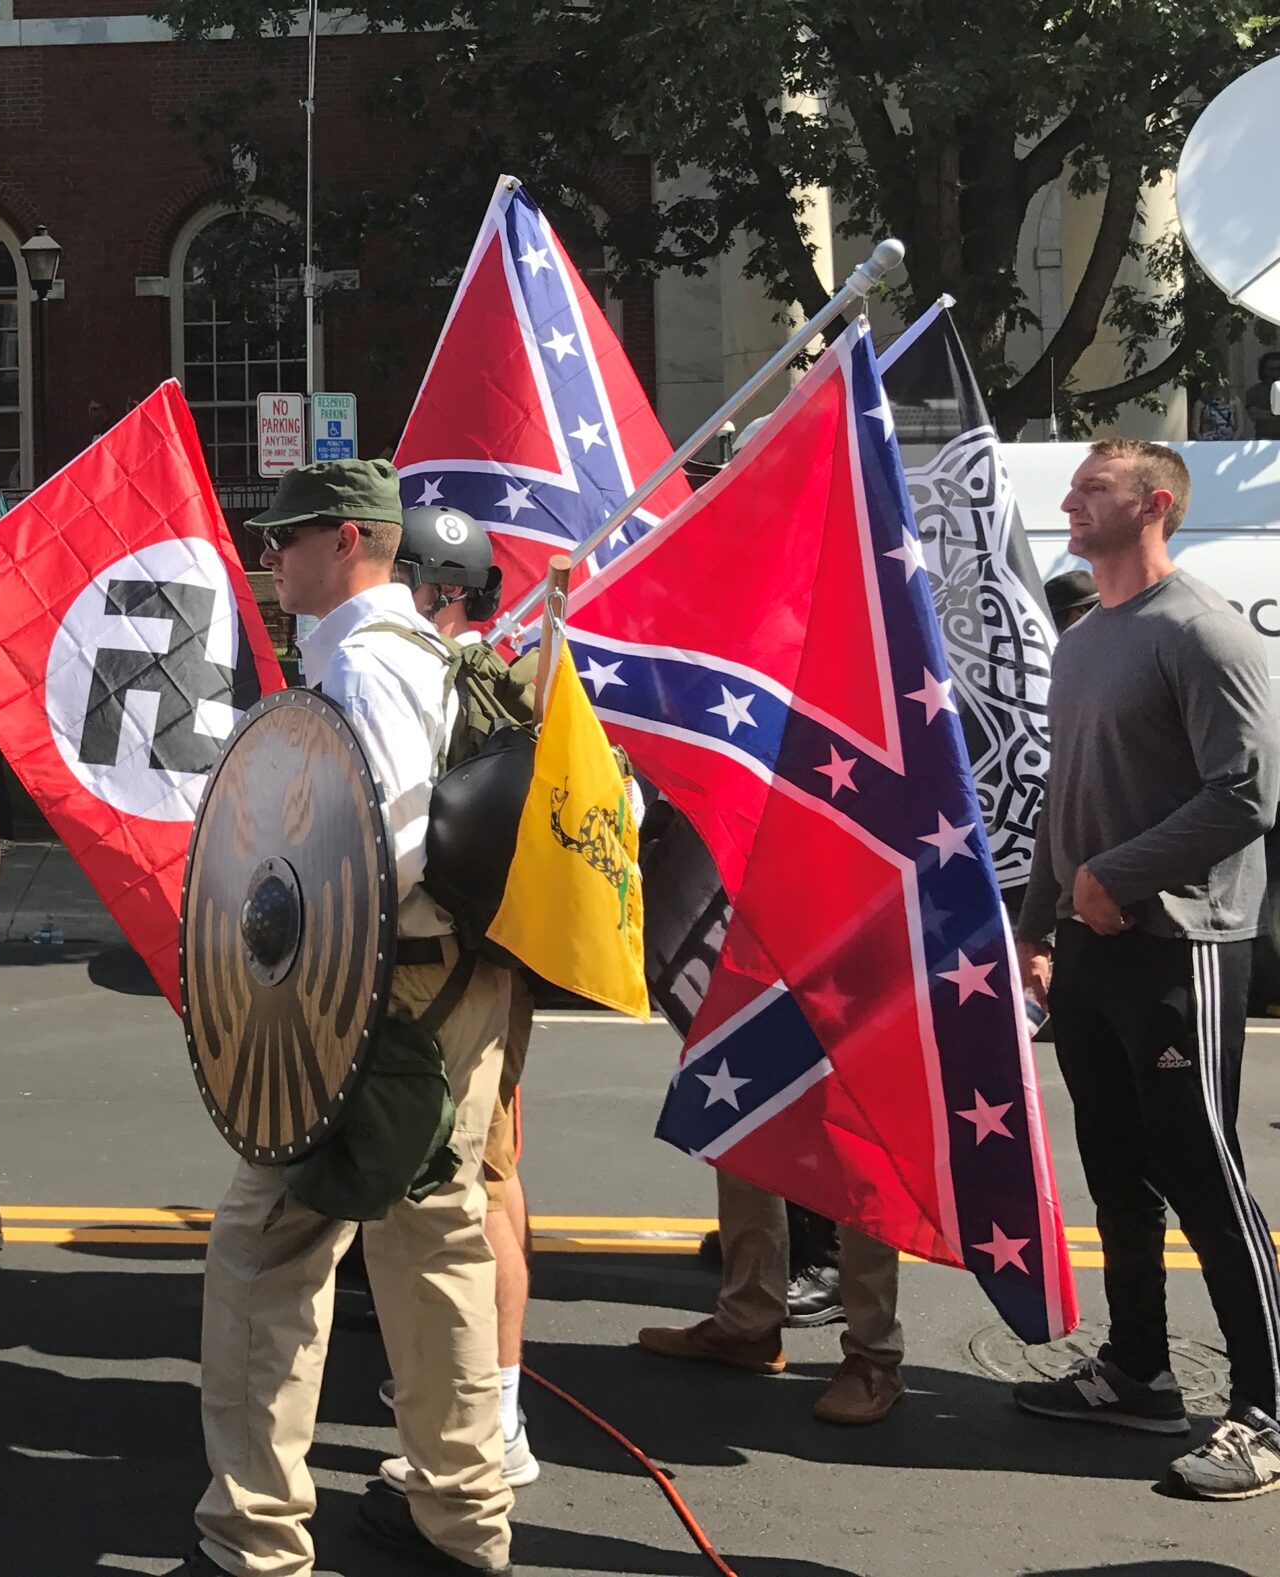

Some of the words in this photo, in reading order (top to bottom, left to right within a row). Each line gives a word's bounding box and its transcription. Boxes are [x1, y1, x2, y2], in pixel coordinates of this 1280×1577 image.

[273, 400, 289, 416] NO
[318, 397, 350, 408] RESERVED
[321, 409, 348, 420] PARKING
[262, 418, 301, 433] PARKING
[265, 436, 298, 446] ANYTIME
[288, 449, 301, 457] ZONE
[443, 516, 461, 541] 8
[1157, 1059, 1191, 1068] adidas
